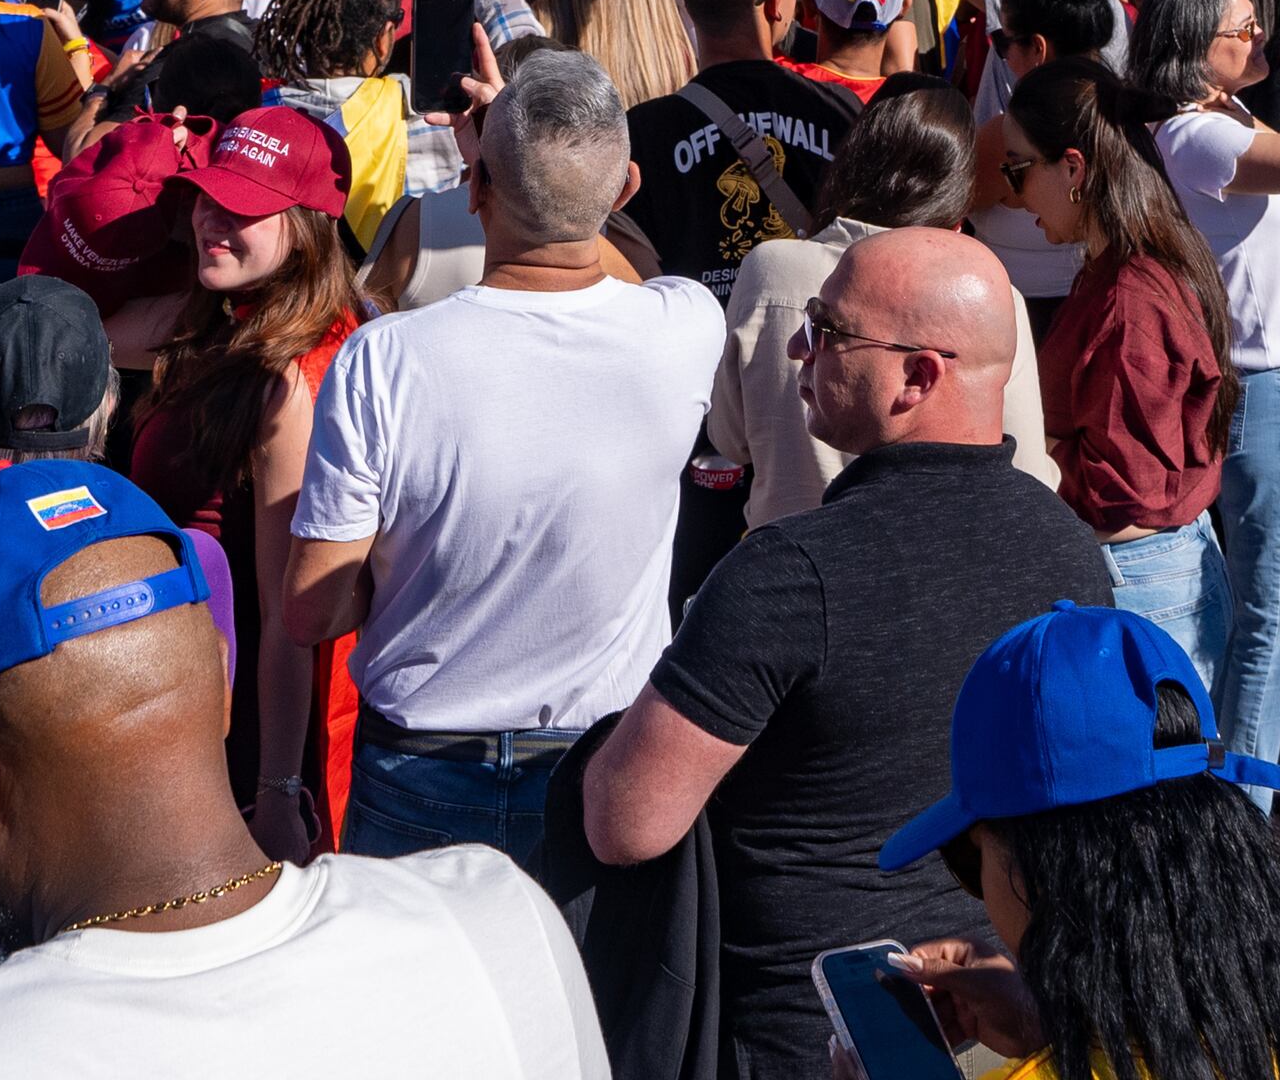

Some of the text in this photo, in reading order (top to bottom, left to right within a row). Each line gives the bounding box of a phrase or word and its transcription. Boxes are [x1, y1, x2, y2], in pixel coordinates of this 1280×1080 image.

[674, 123, 721, 174] OFF
[771, 111, 836, 162] WALL
[240, 144, 276, 168] AGAIN
[63, 218, 86, 248] MAKE
[711, 283, 733, 296] NIN
[694, 471, 734, 483] POWER
